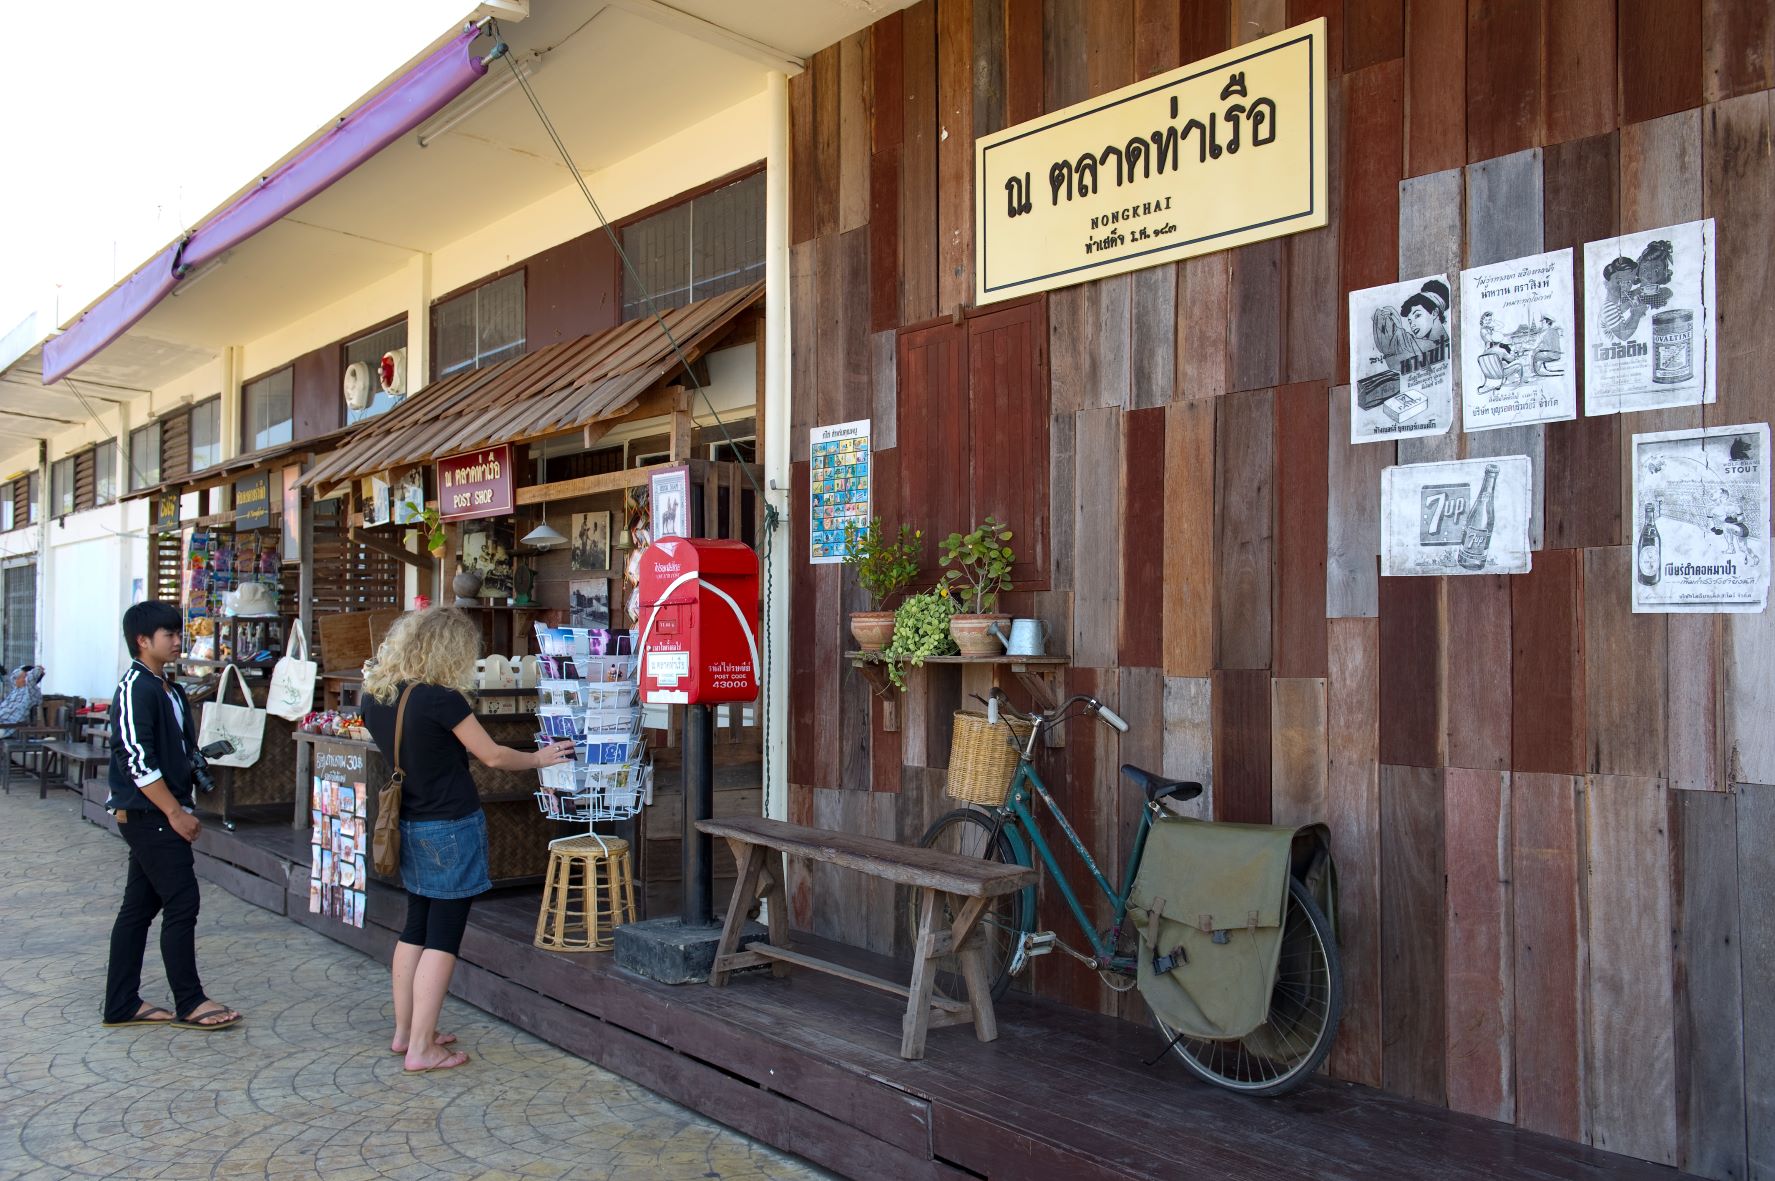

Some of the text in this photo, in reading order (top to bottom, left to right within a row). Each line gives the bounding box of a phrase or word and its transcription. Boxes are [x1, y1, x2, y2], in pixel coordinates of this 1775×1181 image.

[1004, 71, 1277, 218] ณ ตลาดท่าเรือ
[1090, 196, 1172, 231] NONGKHAI
[1085, 228, 1125, 254] ท่าเสด็จ
[1655, 332, 1692, 344] OVALTINE
[1592, 340, 1648, 361] โอวัลติน
[1725, 465, 1758, 474] STOUT
[453, 489, 493, 509] POST SHOP
[712, 680, 748, 689] 43000
